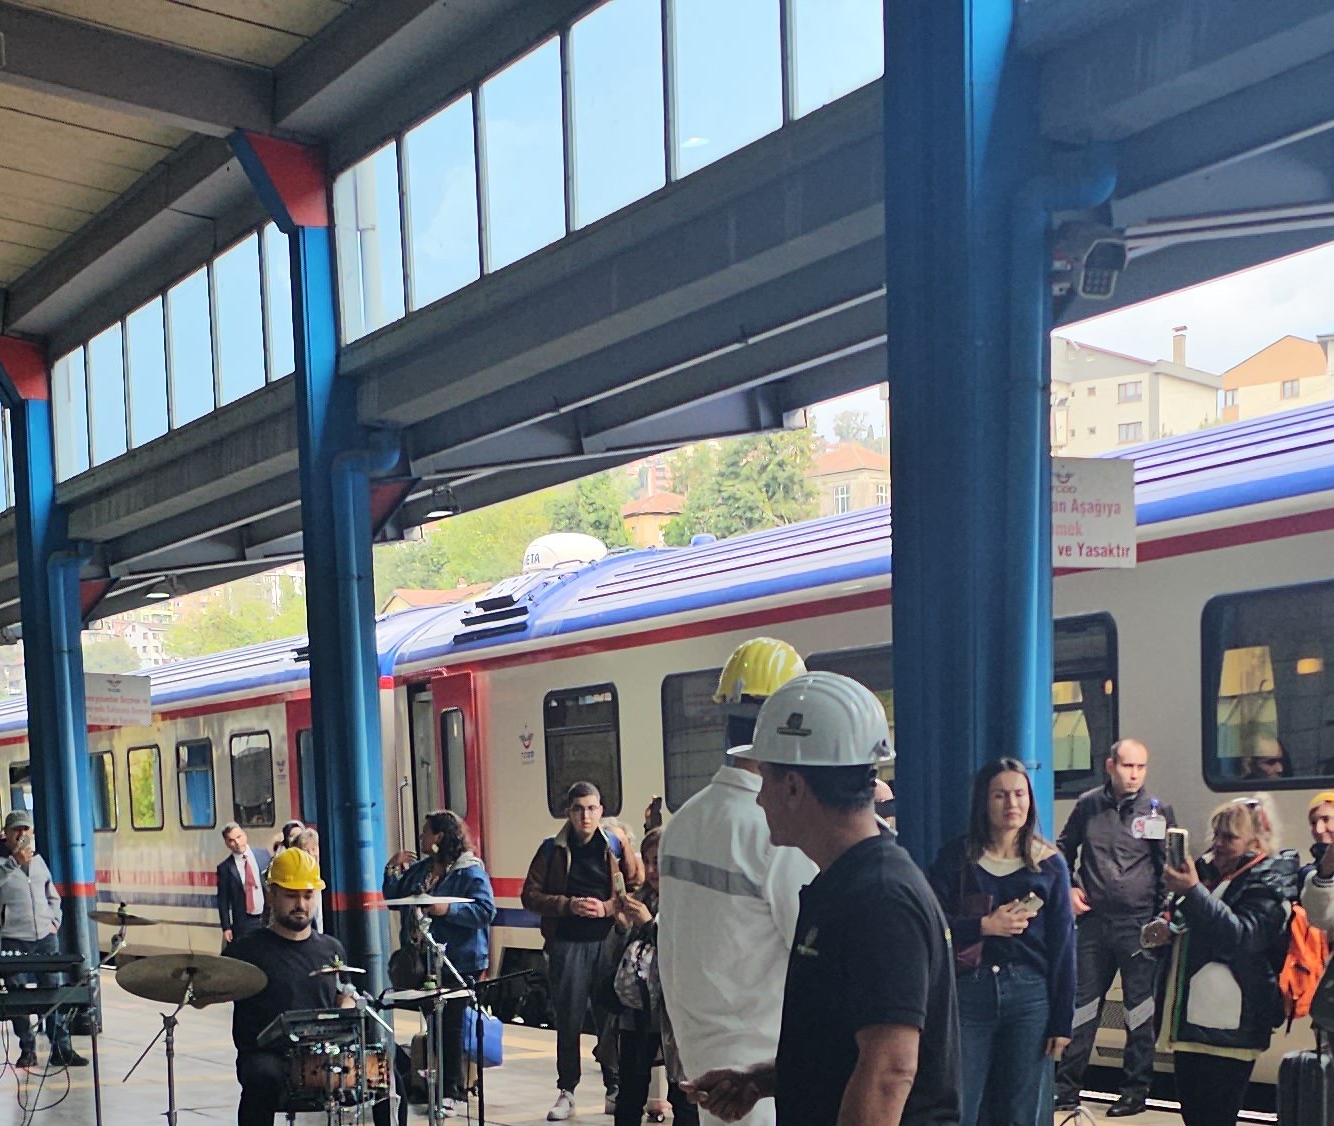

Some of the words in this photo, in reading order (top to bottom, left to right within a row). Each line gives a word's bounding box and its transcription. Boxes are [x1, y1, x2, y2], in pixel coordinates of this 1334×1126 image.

[1071, 498, 1121, 517] Aşağıya
[1058, 545, 1072, 556] ve
[1077, 542, 1130, 557] Yasaktır
